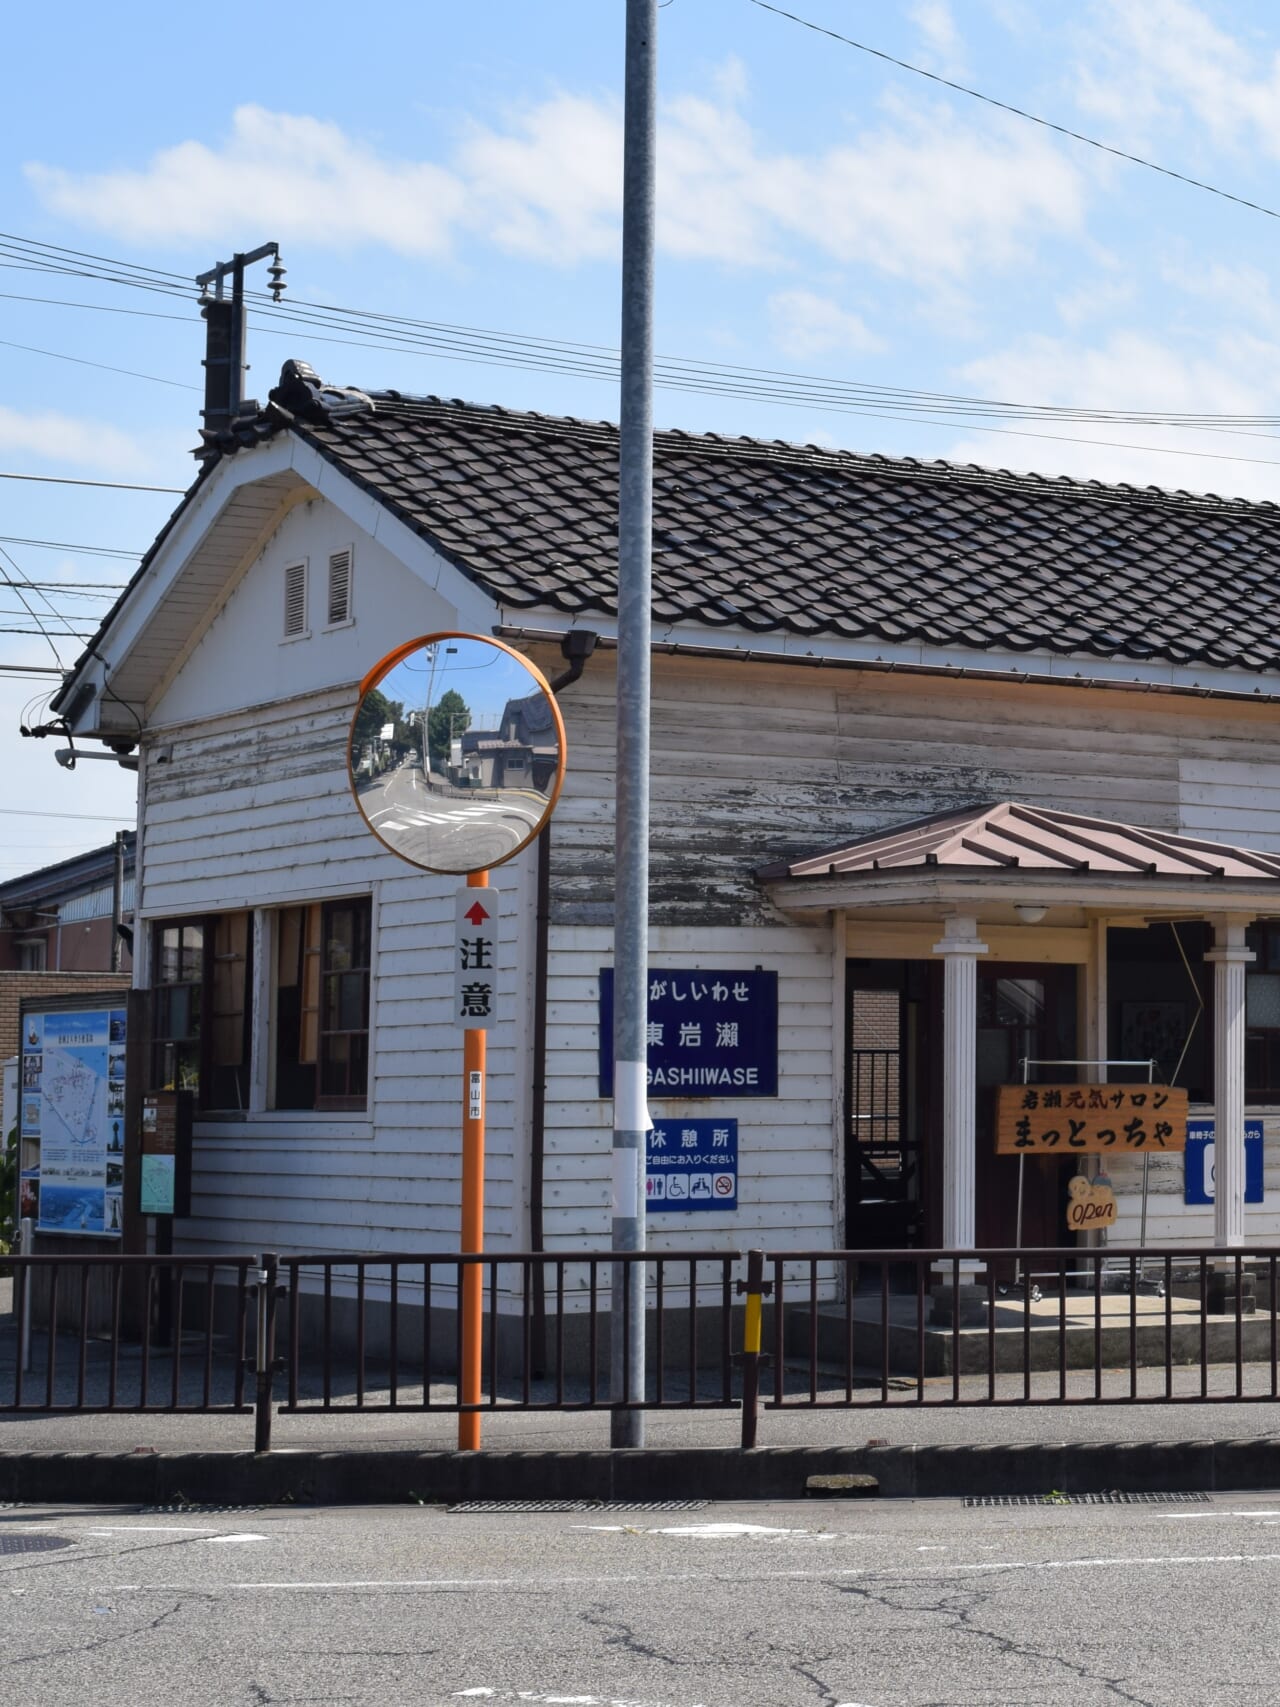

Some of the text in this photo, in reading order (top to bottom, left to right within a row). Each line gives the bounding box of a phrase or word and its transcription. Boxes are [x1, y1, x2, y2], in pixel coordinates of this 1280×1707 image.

[460, 936, 493, 1017] 注意
[650, 980, 750, 1002] がしいわせ
[647, 1067, 759, 1086] GASHIIWASE
[470, 1073, 481, 1118] 富山市
[1022, 1088, 1169, 1109] 岩瀬元気サロン
[650, 1129, 729, 1149] 休憩所
